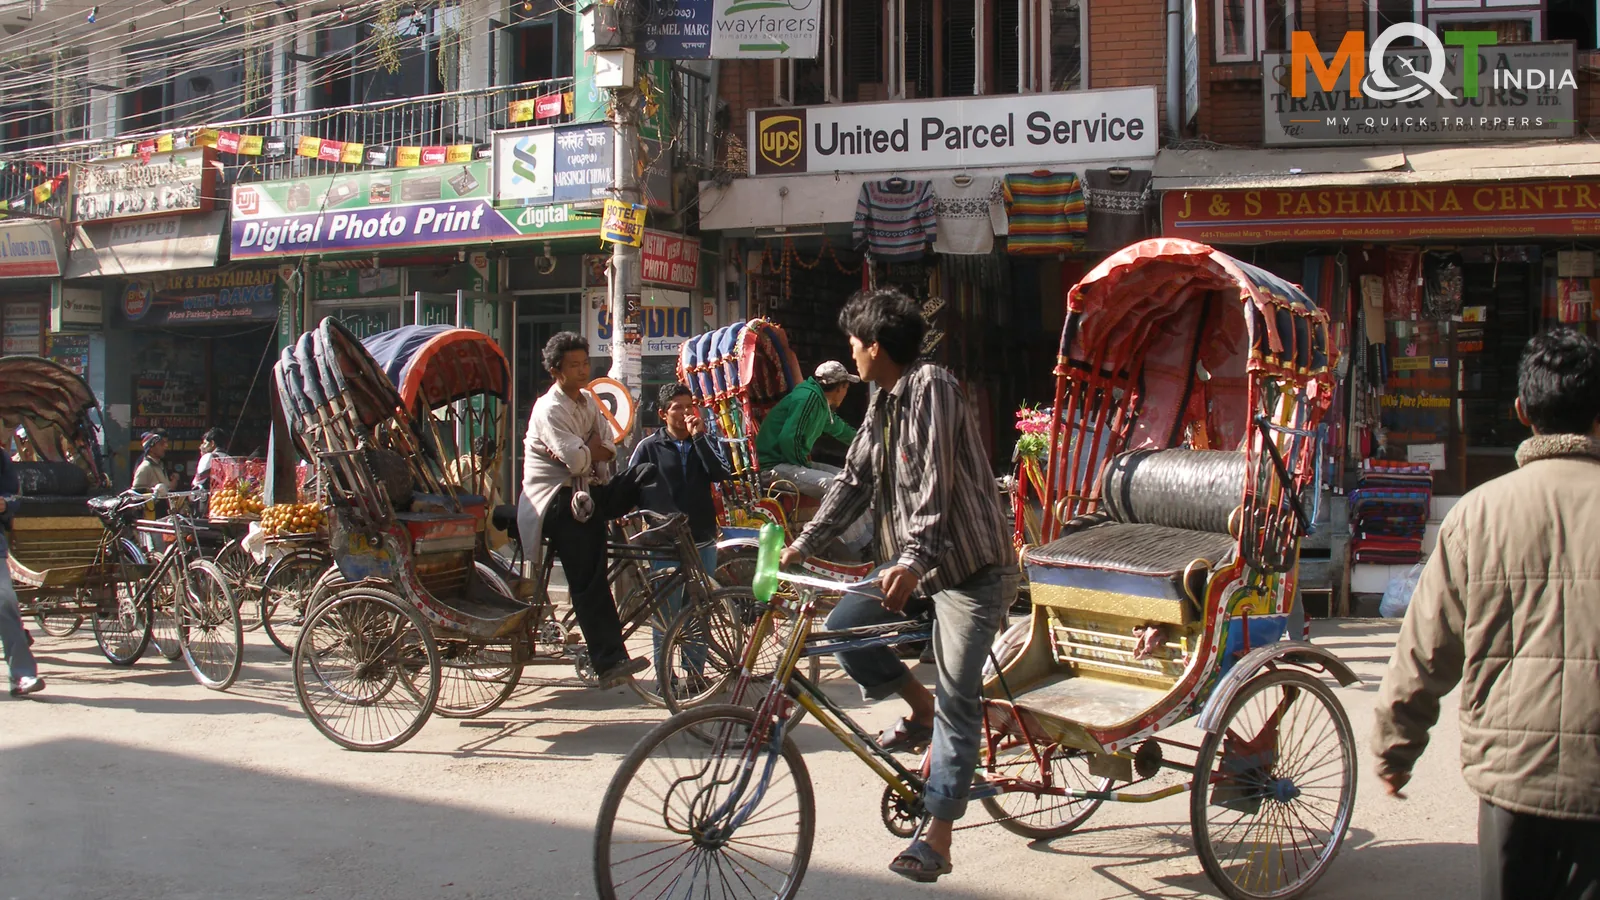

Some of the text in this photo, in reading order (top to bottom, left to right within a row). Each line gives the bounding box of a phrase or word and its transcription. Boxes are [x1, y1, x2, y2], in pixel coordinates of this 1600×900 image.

[684, 23, 710, 36] MARG
[716, 15, 815, 33] wayfarers
[763, 131, 800, 158] ups
[814, 111, 1144, 156] United Parcel Service
[1178, 184, 1600, 219] J & S PASHMINA CENTR
[516, 204, 568, 228] digital
[607, 205, 636, 221] HOTEL
[145, 221, 176, 236] PUB
[240, 216, 324, 252] Digital
[328, 211, 407, 241] Photo
[413, 203, 485, 234] Print
[198, 269, 279, 288] RESTAURANT
[643, 258, 694, 284] PHOTO GOODS
[219, 284, 275, 306] DANCE
[168, 311, 185, 320] More
[186, 310, 211, 320] Parking
[212, 309, 231, 318] Space
[598, 305, 692, 340] SDIO
[1399, 395, 1416, 408] Pure
[1417, 394, 1450, 408] Pashmina
